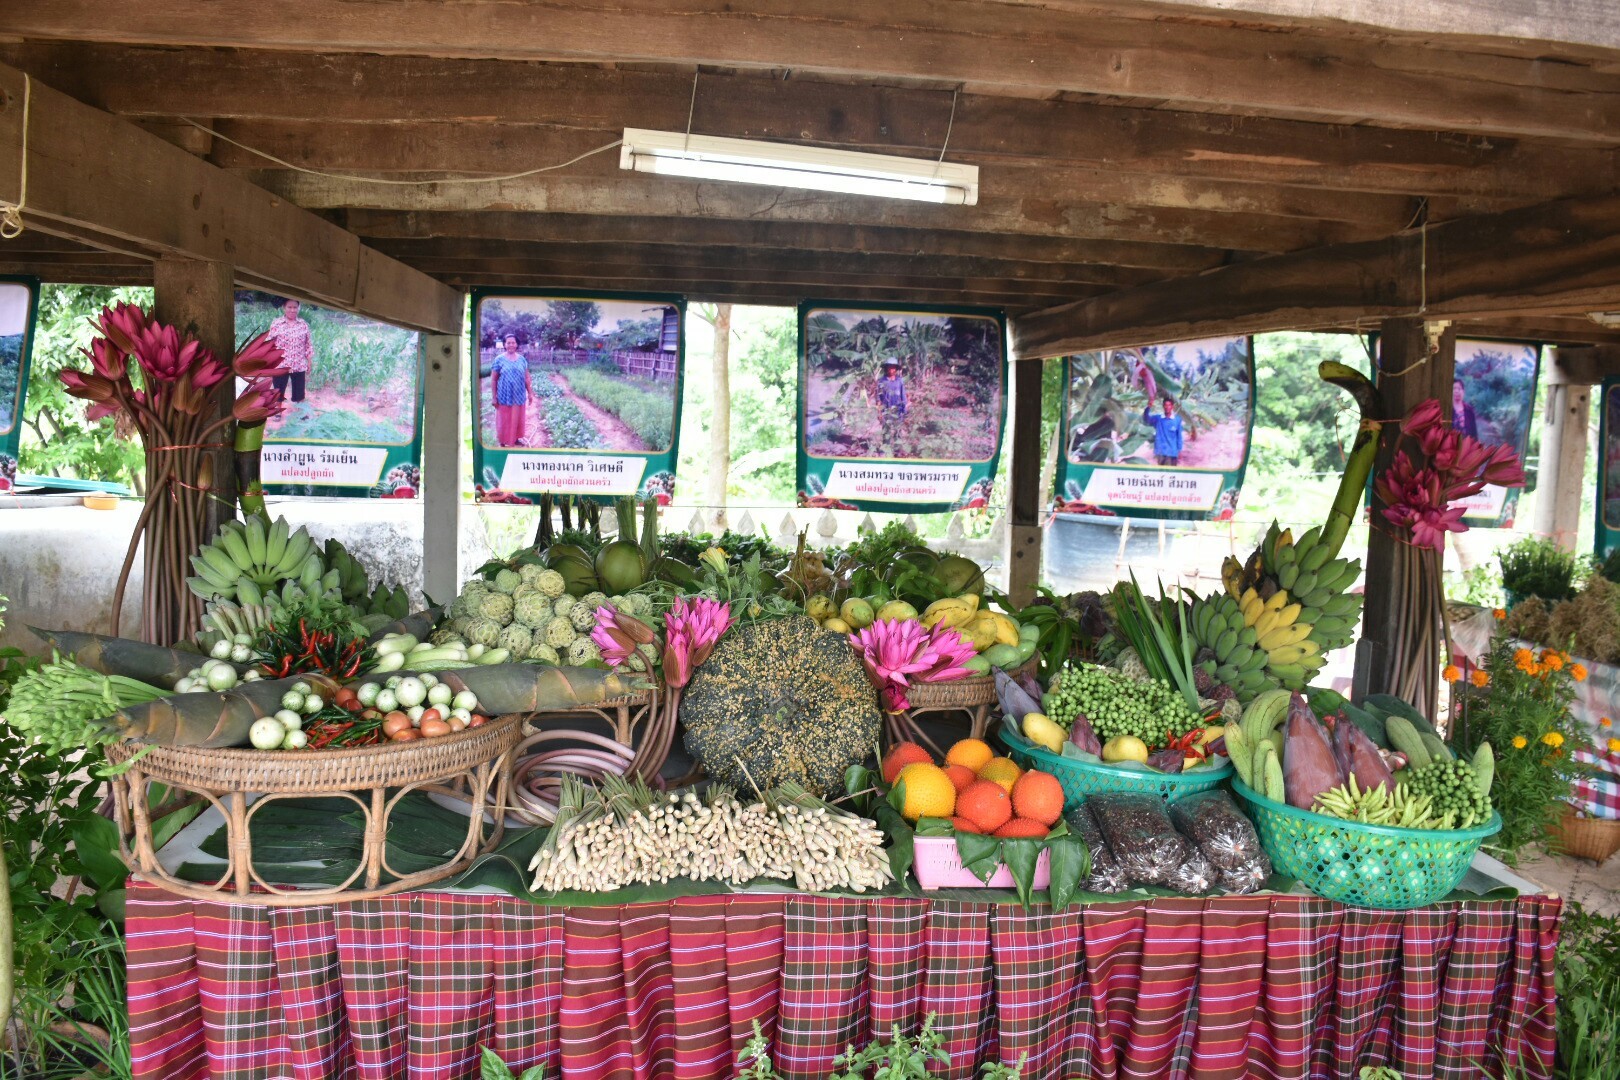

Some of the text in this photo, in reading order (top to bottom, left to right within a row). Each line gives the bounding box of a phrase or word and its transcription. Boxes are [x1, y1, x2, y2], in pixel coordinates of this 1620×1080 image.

[320, 449, 358, 464] ร่มเย็น
[281, 466, 334, 480] แปลงปลูกผัก
[522, 459, 624, 473] นางทองนาค วิเศษดี
[530, 474, 612, 488] แปลงปลูกผักสวนครัว
[839, 469, 894, 480] นางสมทรง
[855, 482, 936, 496] แปลงปลูกผักสวนครัว
